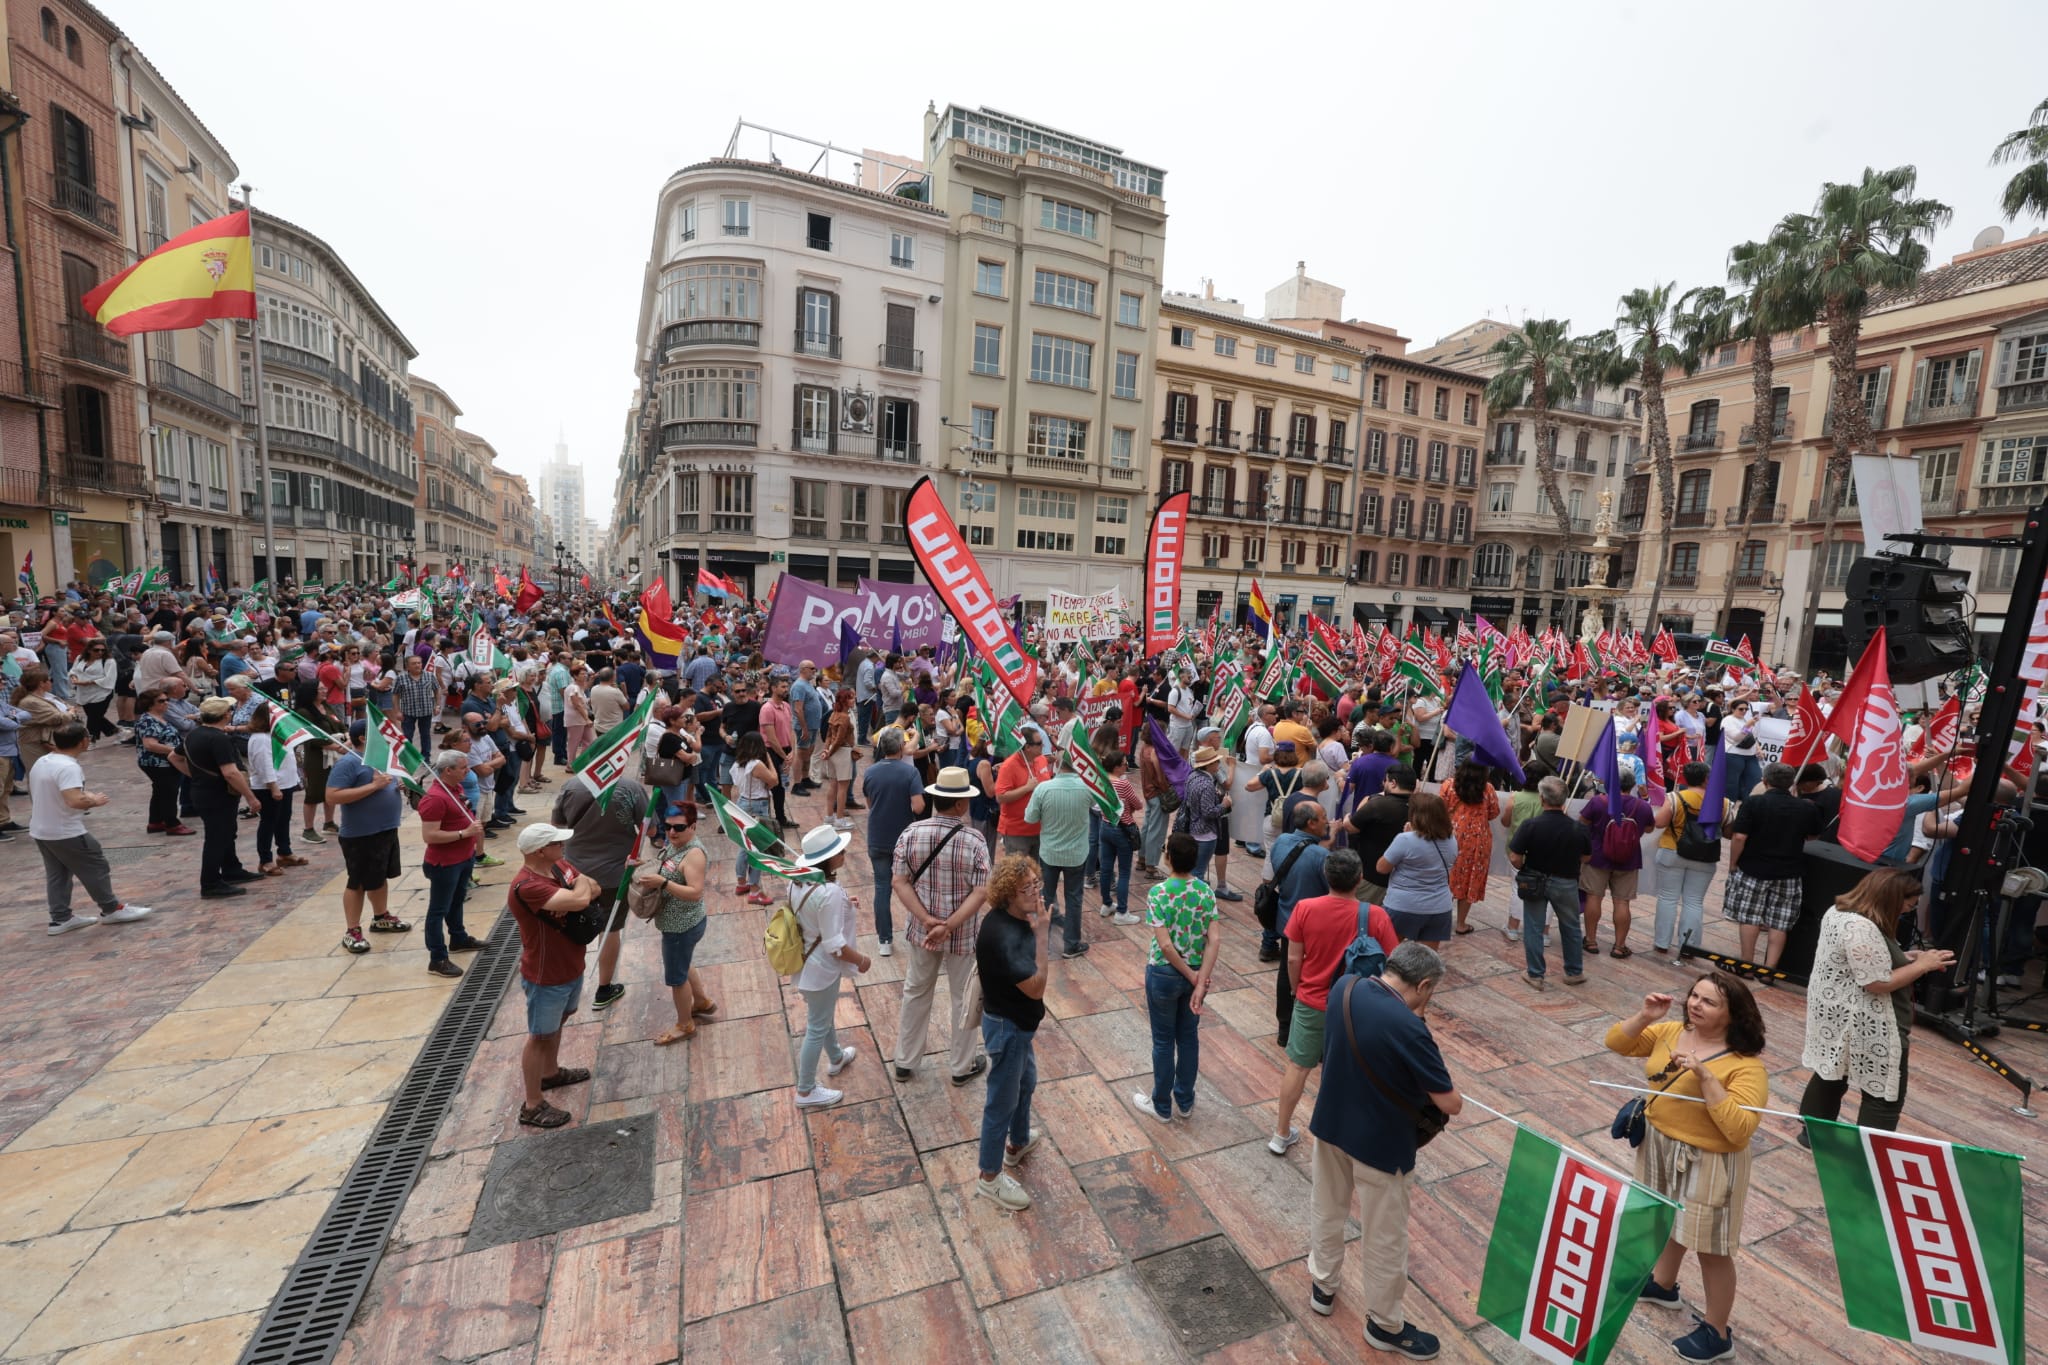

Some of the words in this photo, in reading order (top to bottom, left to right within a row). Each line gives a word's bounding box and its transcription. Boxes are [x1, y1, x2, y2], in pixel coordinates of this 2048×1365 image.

[909, 512, 1008, 647] CCOO
[1154, 511, 1179, 608] CCOO
[883, 626, 929, 640] CMBIO
[1046, 627, 1059, 640] NO
[1064, 626, 1077, 639] AL
[1052, 611, 1110, 625] MARBEA
[1549, 1172, 1607, 1315] CCOO
[1886, 1148, 1969, 1298] CCOO
